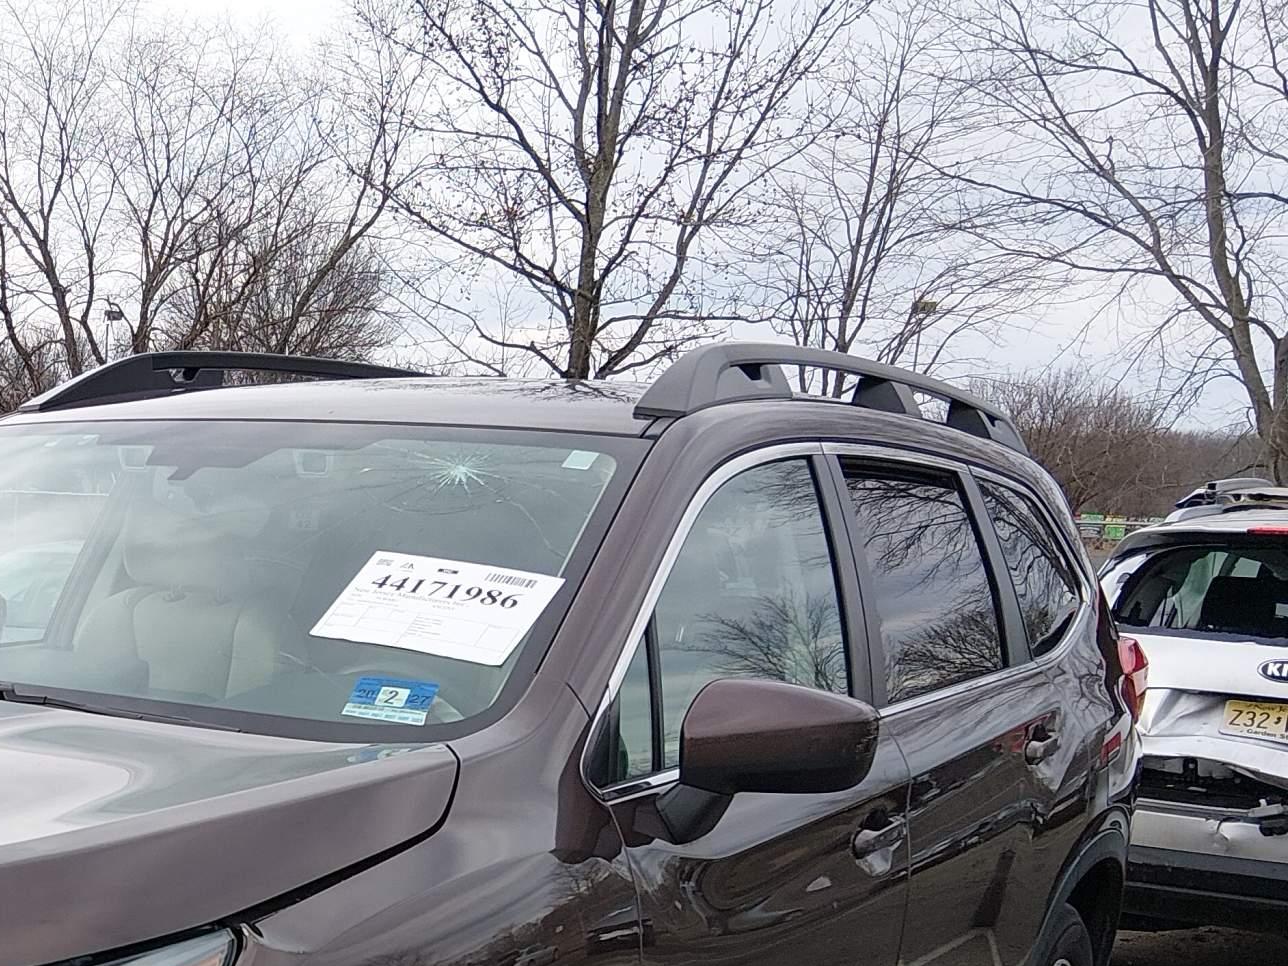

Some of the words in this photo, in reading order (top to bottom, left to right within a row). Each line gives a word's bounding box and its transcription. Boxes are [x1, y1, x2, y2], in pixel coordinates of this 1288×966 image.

[372, 574, 524, 609] 44171986
[384, 690, 399, 704] 2
[409, 695, 431, 705] 27
